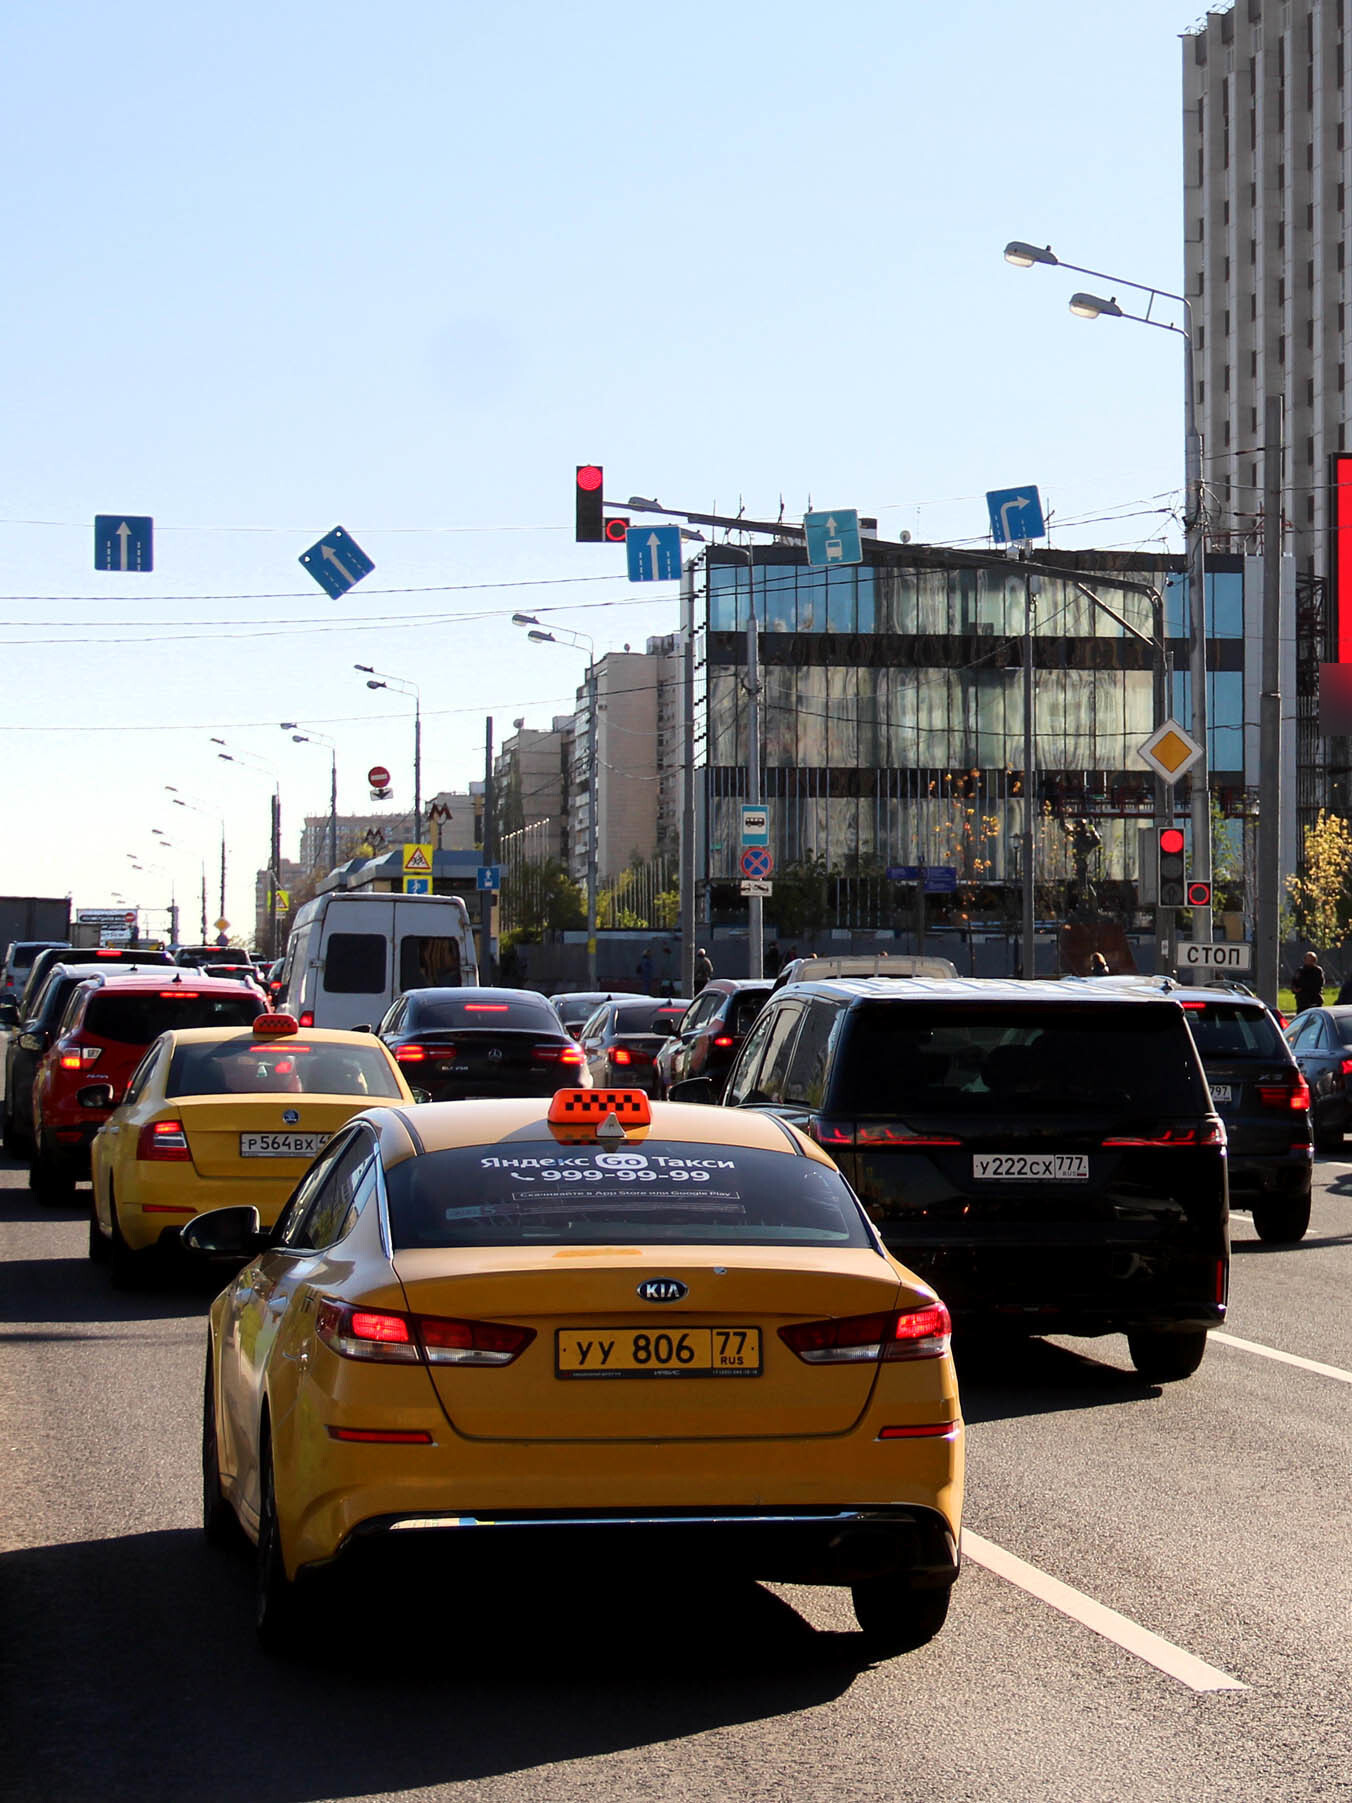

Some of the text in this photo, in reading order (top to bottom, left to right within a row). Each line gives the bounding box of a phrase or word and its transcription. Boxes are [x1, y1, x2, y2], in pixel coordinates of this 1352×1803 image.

[1187, 946, 1240, 965] СТОП
[248, 1135, 314, 1150] Р564ВХ
[480, 1157, 590, 1168] Яндекс
[651, 1156, 735, 1169] Такси
[980, 1156, 1083, 1175] У222СХ 777
[540, 1170, 710, 1181] 999-99-99
[646, 1283, 680, 1298] KIA
[632, 1333, 695, 1365] 806
[715, 1331, 748, 1356] 77
[720, 1356, 744, 1366] RUS
